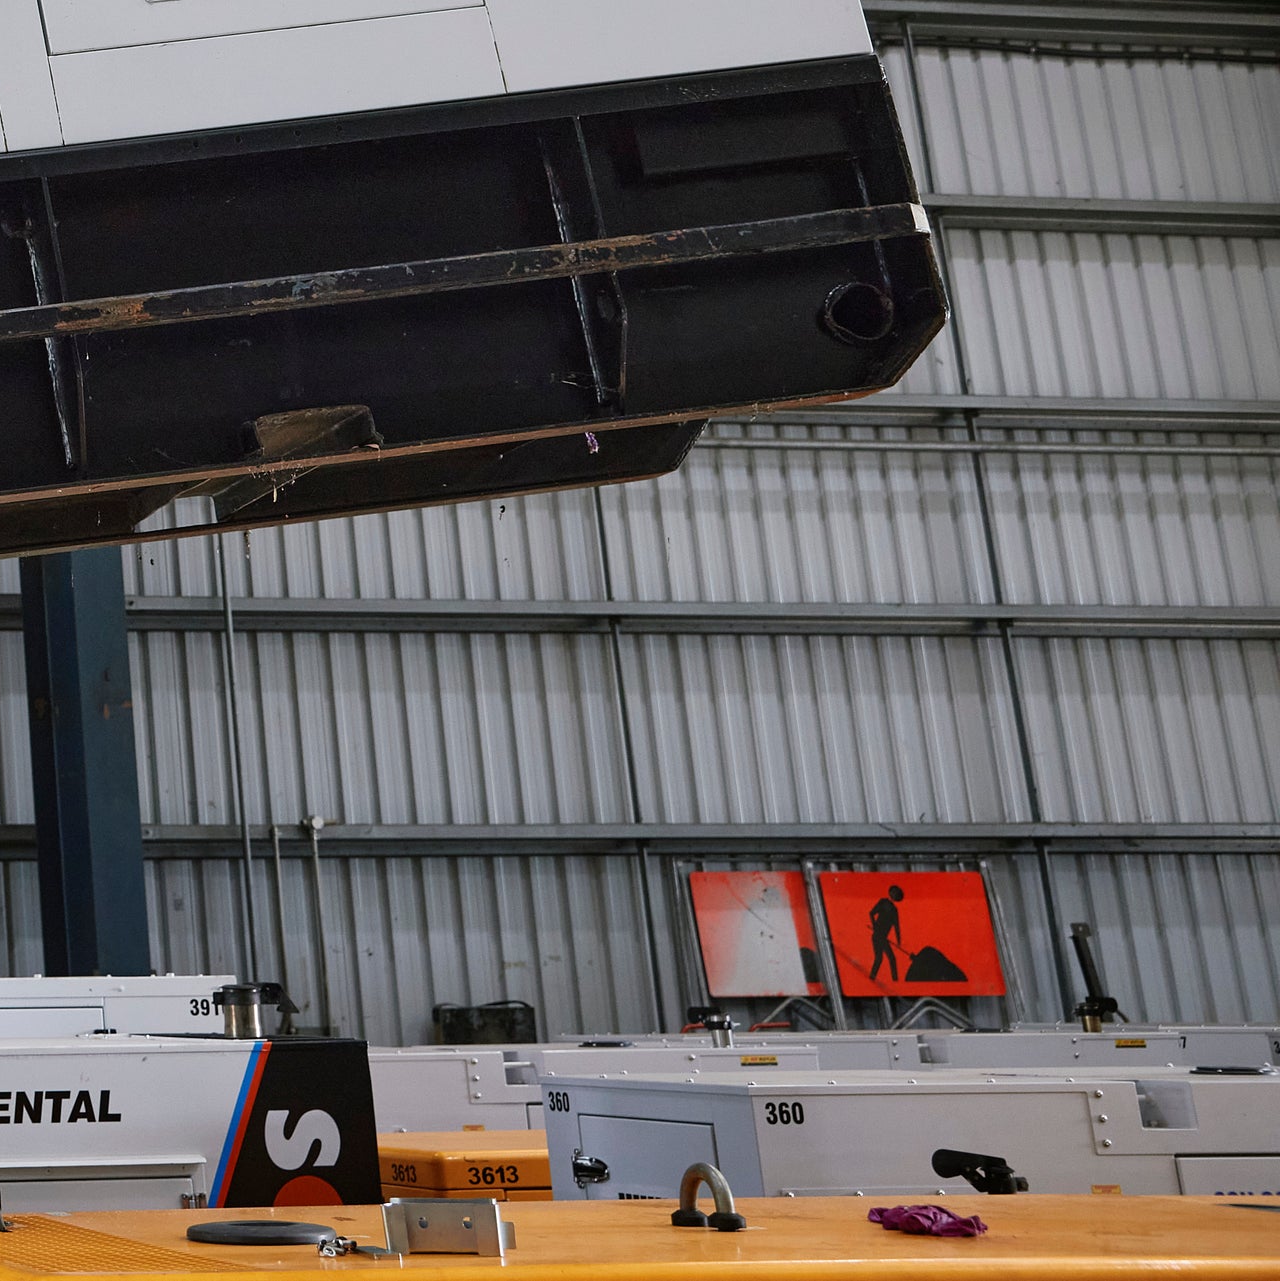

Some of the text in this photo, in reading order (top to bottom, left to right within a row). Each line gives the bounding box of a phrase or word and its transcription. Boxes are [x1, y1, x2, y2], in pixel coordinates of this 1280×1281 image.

[548, 1091, 570, 1113] 360
[764, 1101, 805, 1125] 360
[391, 1164, 417, 1184] 3613
[467, 1165, 519, 1185] 3613
